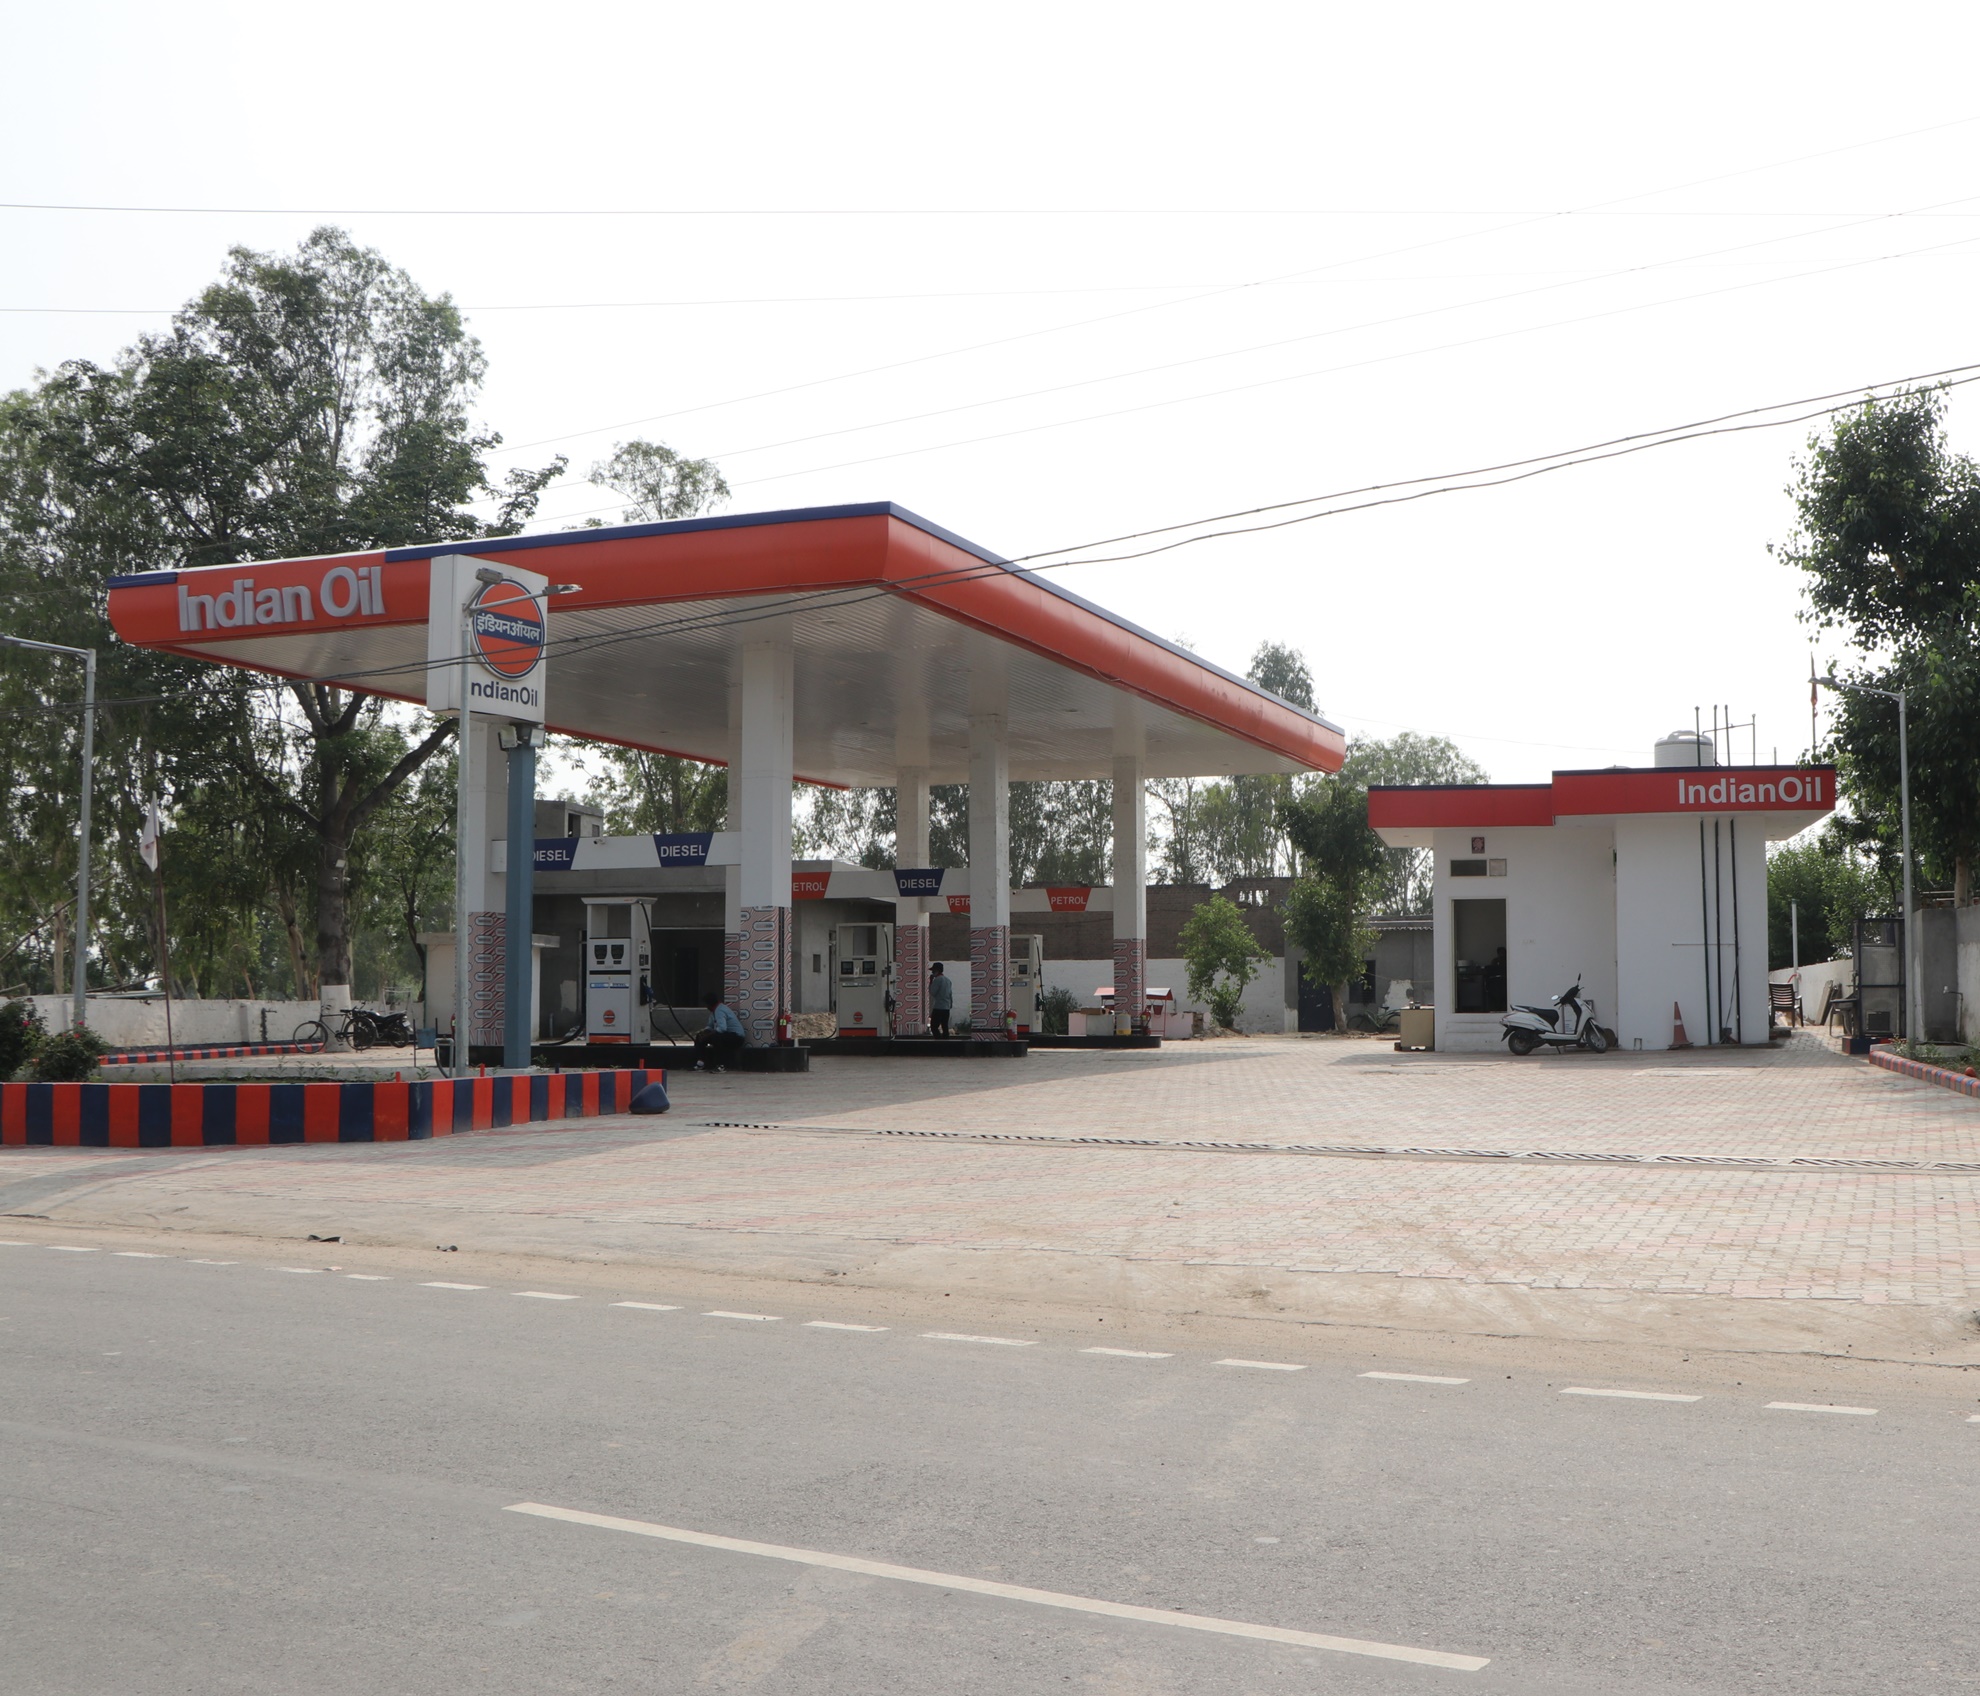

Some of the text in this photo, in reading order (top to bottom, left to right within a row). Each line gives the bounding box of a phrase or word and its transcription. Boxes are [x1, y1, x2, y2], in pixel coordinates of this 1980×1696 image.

[178, 566, 386, 632] Indian Oil
[477, 612, 541, 641] इंडियनऑयल
[470, 680, 538, 707] ndianOil
[1678, 776, 1822, 805] IndianOil
[660, 844, 706, 858] DIESEL
[792, 881, 826, 892] ETROL
[900, 878, 939, 889] DIESEL
[949, 897, 971, 906] PETR
[1050, 896, 1087, 905] PETROL
